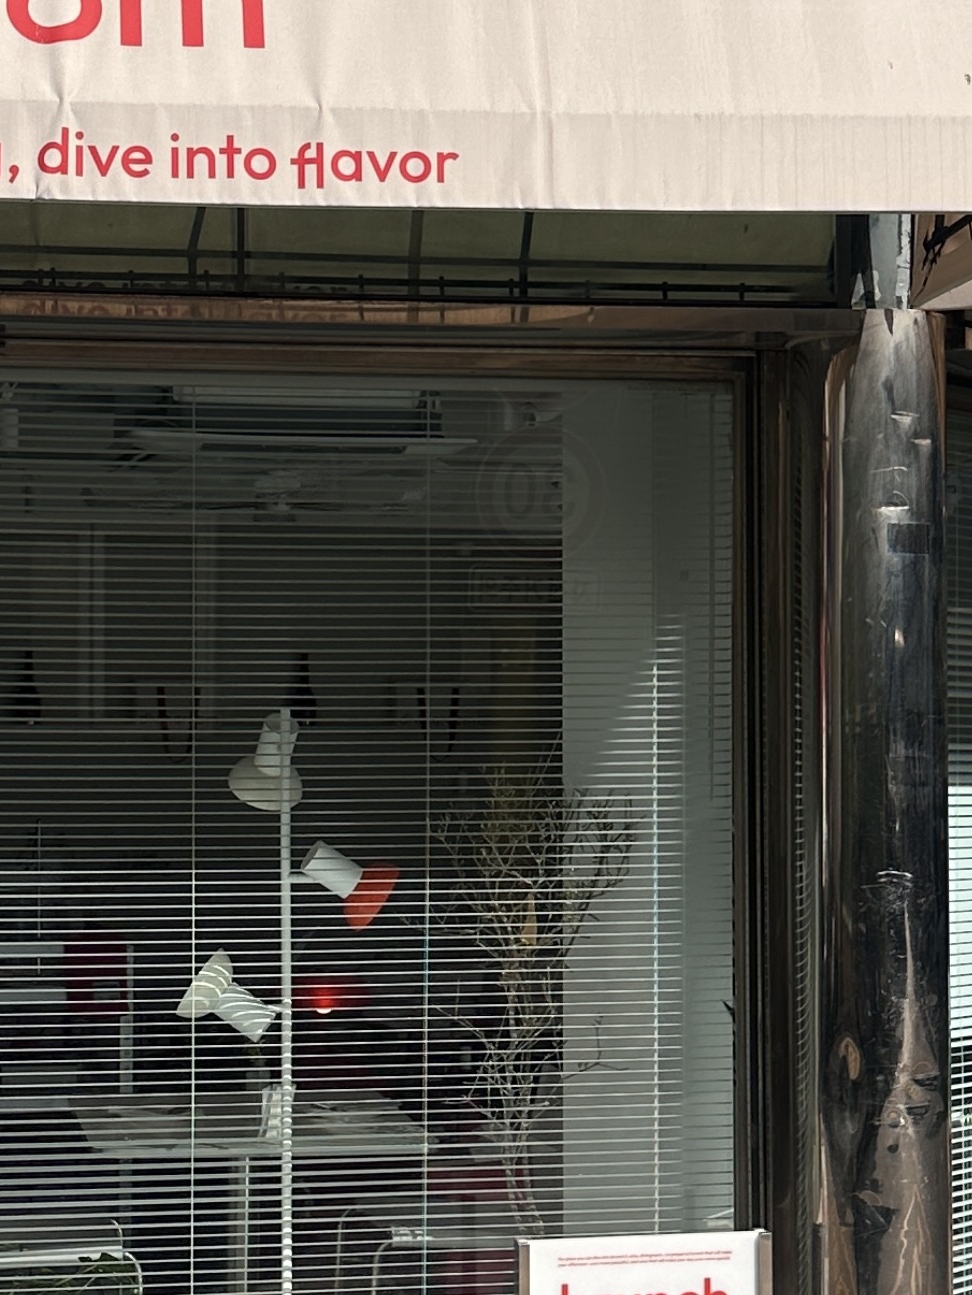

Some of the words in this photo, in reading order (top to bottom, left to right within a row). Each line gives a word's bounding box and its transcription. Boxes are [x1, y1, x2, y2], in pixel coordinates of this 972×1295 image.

[37, 127, 153, 178] dive
[170, 133, 277, 180] into
[290, 141, 460, 189] flavor
